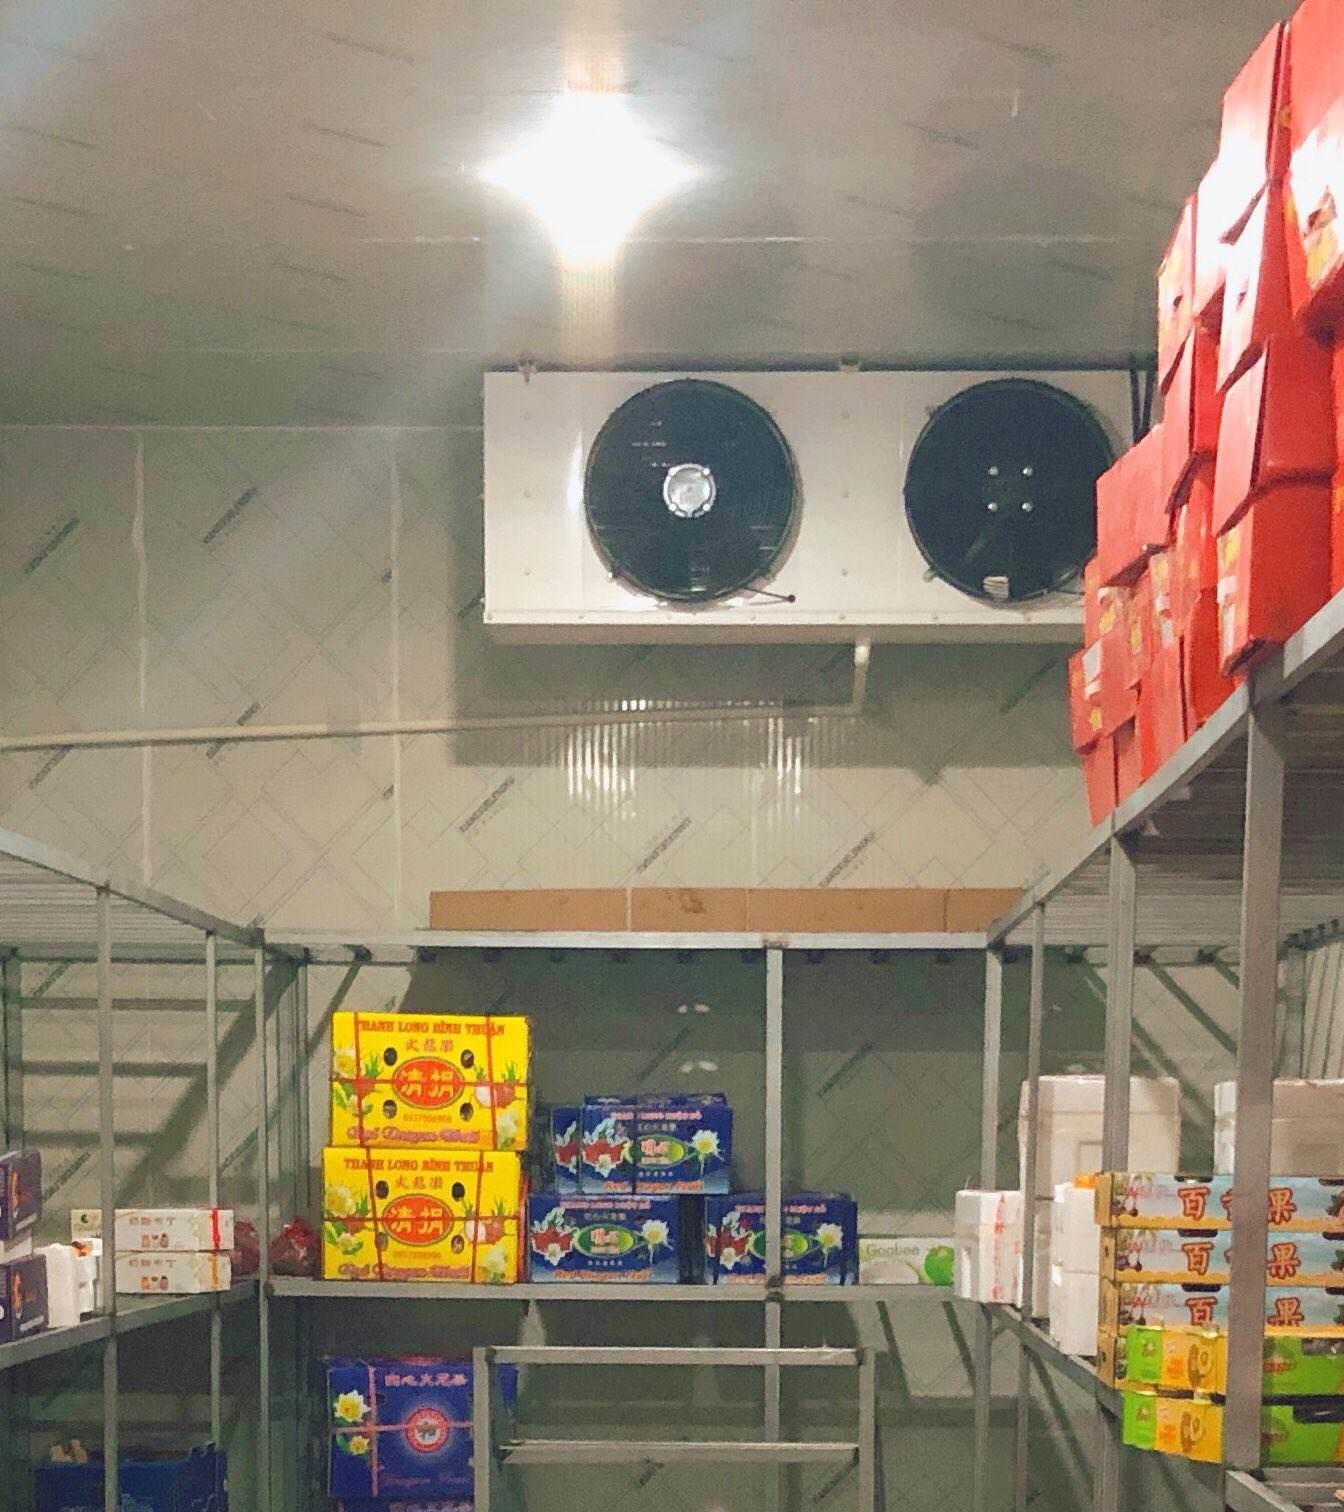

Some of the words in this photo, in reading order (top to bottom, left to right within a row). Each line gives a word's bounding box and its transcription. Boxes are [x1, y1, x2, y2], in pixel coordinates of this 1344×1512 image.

[1177, 1186, 1297, 1225] 百果
[1181, 1241, 1302, 1280] 百果
[1185, 1296, 1306, 1326] 百果
